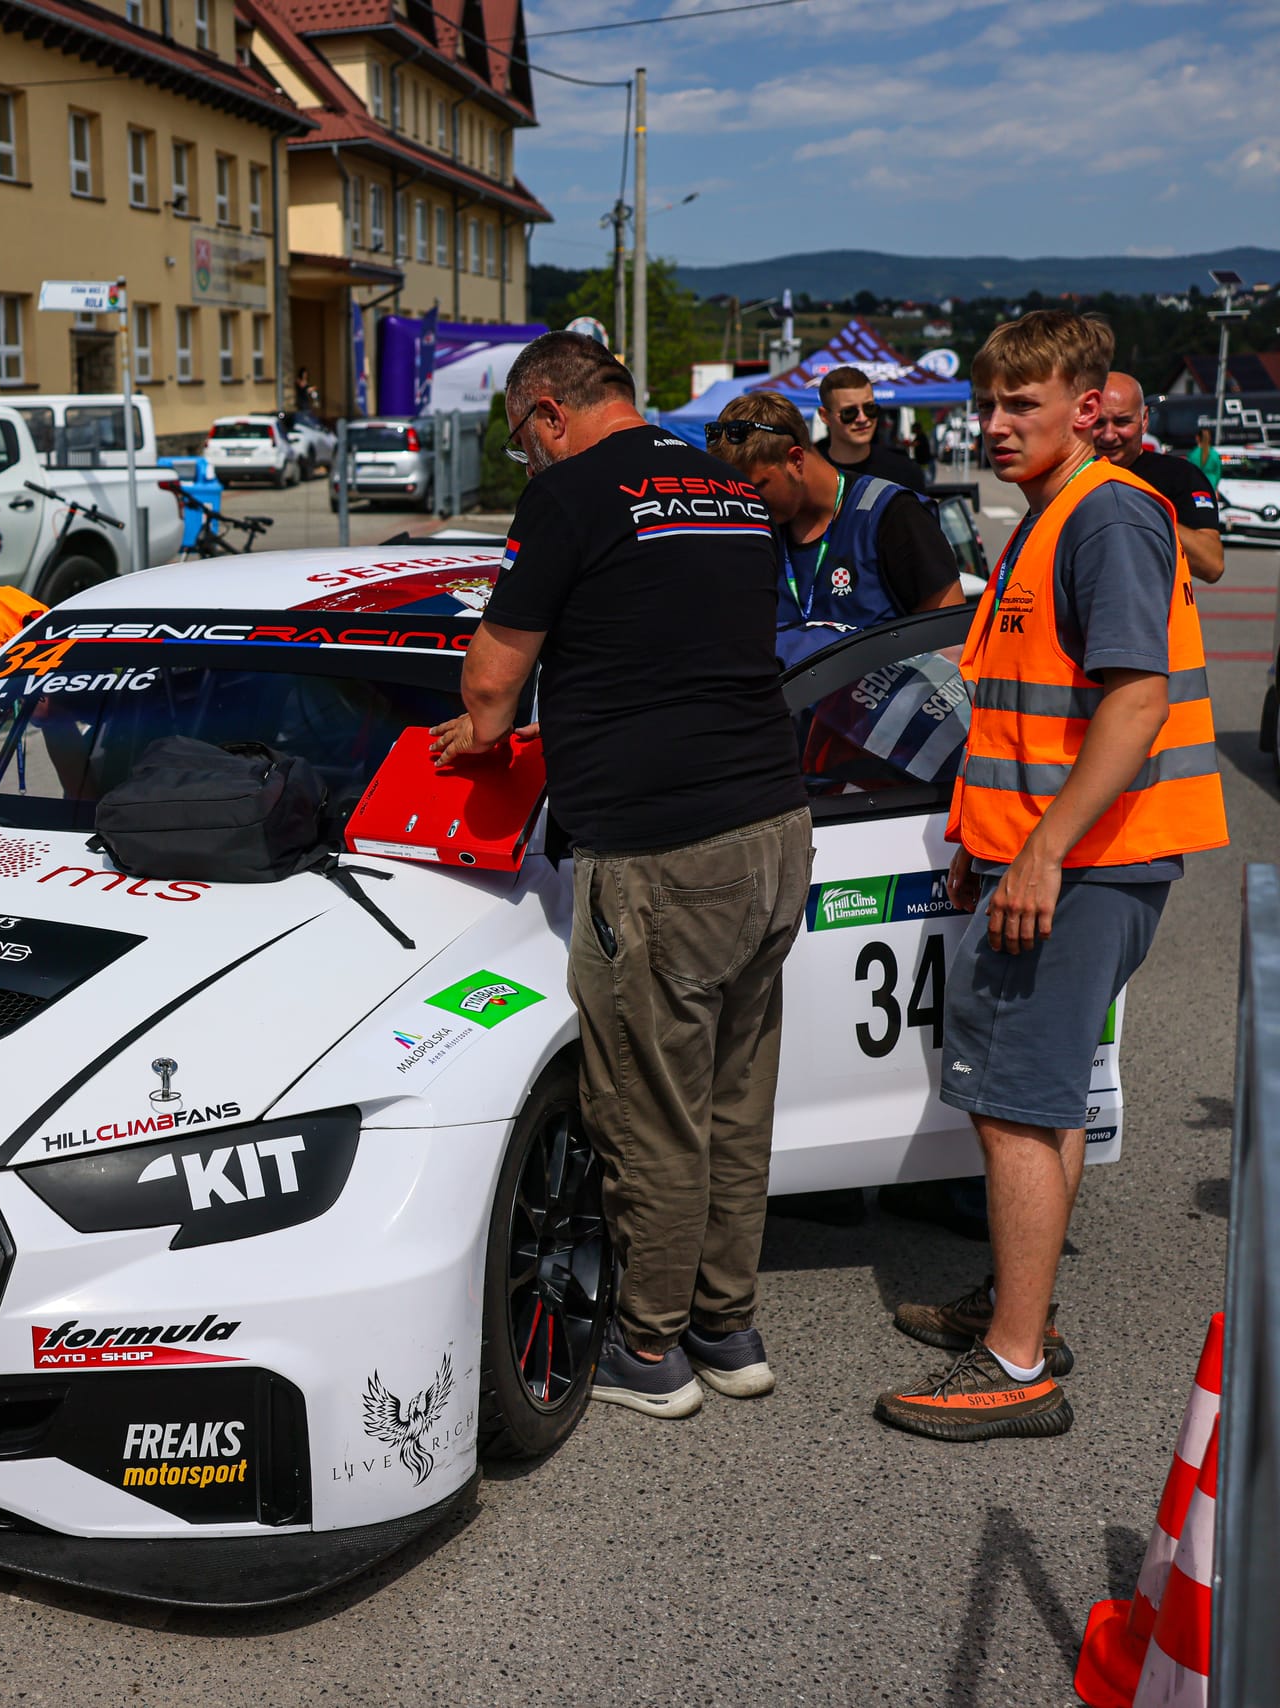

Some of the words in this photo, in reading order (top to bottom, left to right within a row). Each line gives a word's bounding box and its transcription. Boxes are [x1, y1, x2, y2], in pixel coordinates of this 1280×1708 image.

[619, 476, 761, 500] VESNIC
[307, 554, 506, 588] SERBIA
[831, 585, 853, 597] PZM
[999, 614, 1025, 634] BK
[23, 667, 160, 695] Vesnić
[37, 865, 212, 902] mts
[834, 897, 849, 909] Hill
[850, 893, 877, 907] Climb
[835, 906, 879, 919] Limanowa
[907, 900, 956, 914] MAŁOPO
[464, 984, 513, 1009] TYMBARK
[854, 934, 946, 1058] 34
[396, 1027, 453, 1074] MAŁOPOLSKA
[428, 1049, 447, 1065] Arena
[181, 1134, 306, 1211] KIT
[38, 1314, 242, 1350] formula
[101, 1350, 154, 1362] SHOP
[967, 1390, 1026, 1407] SPLY-350
[123, 1420, 245, 1460] FREAKS
[122, 1459, 248, 1489] motorsport
